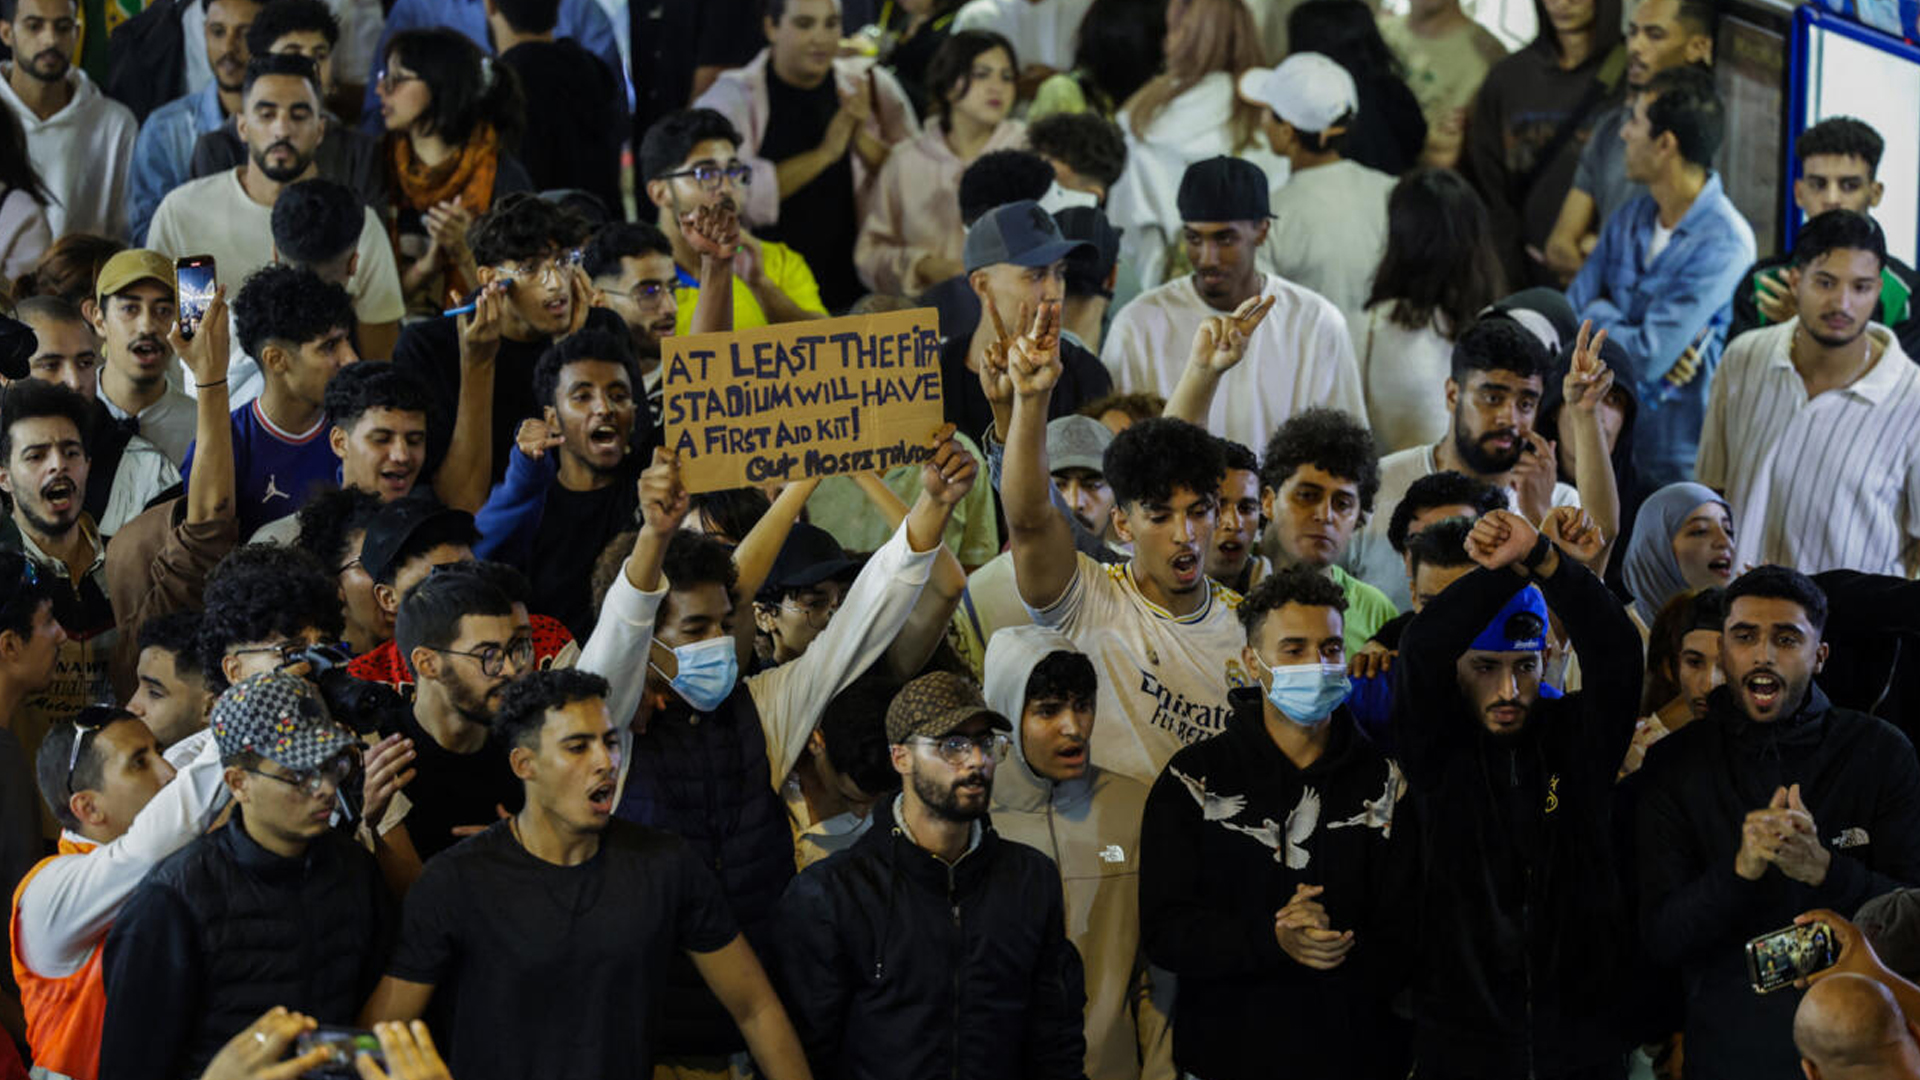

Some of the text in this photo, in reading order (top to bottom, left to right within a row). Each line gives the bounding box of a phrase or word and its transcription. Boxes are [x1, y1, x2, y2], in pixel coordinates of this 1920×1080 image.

[667, 351, 716, 385] AT
[729, 336, 826, 379] LEAST
[794, 376, 858, 406] WILL
[861, 372, 940, 407] HAVE
[675, 429, 698, 458] A
